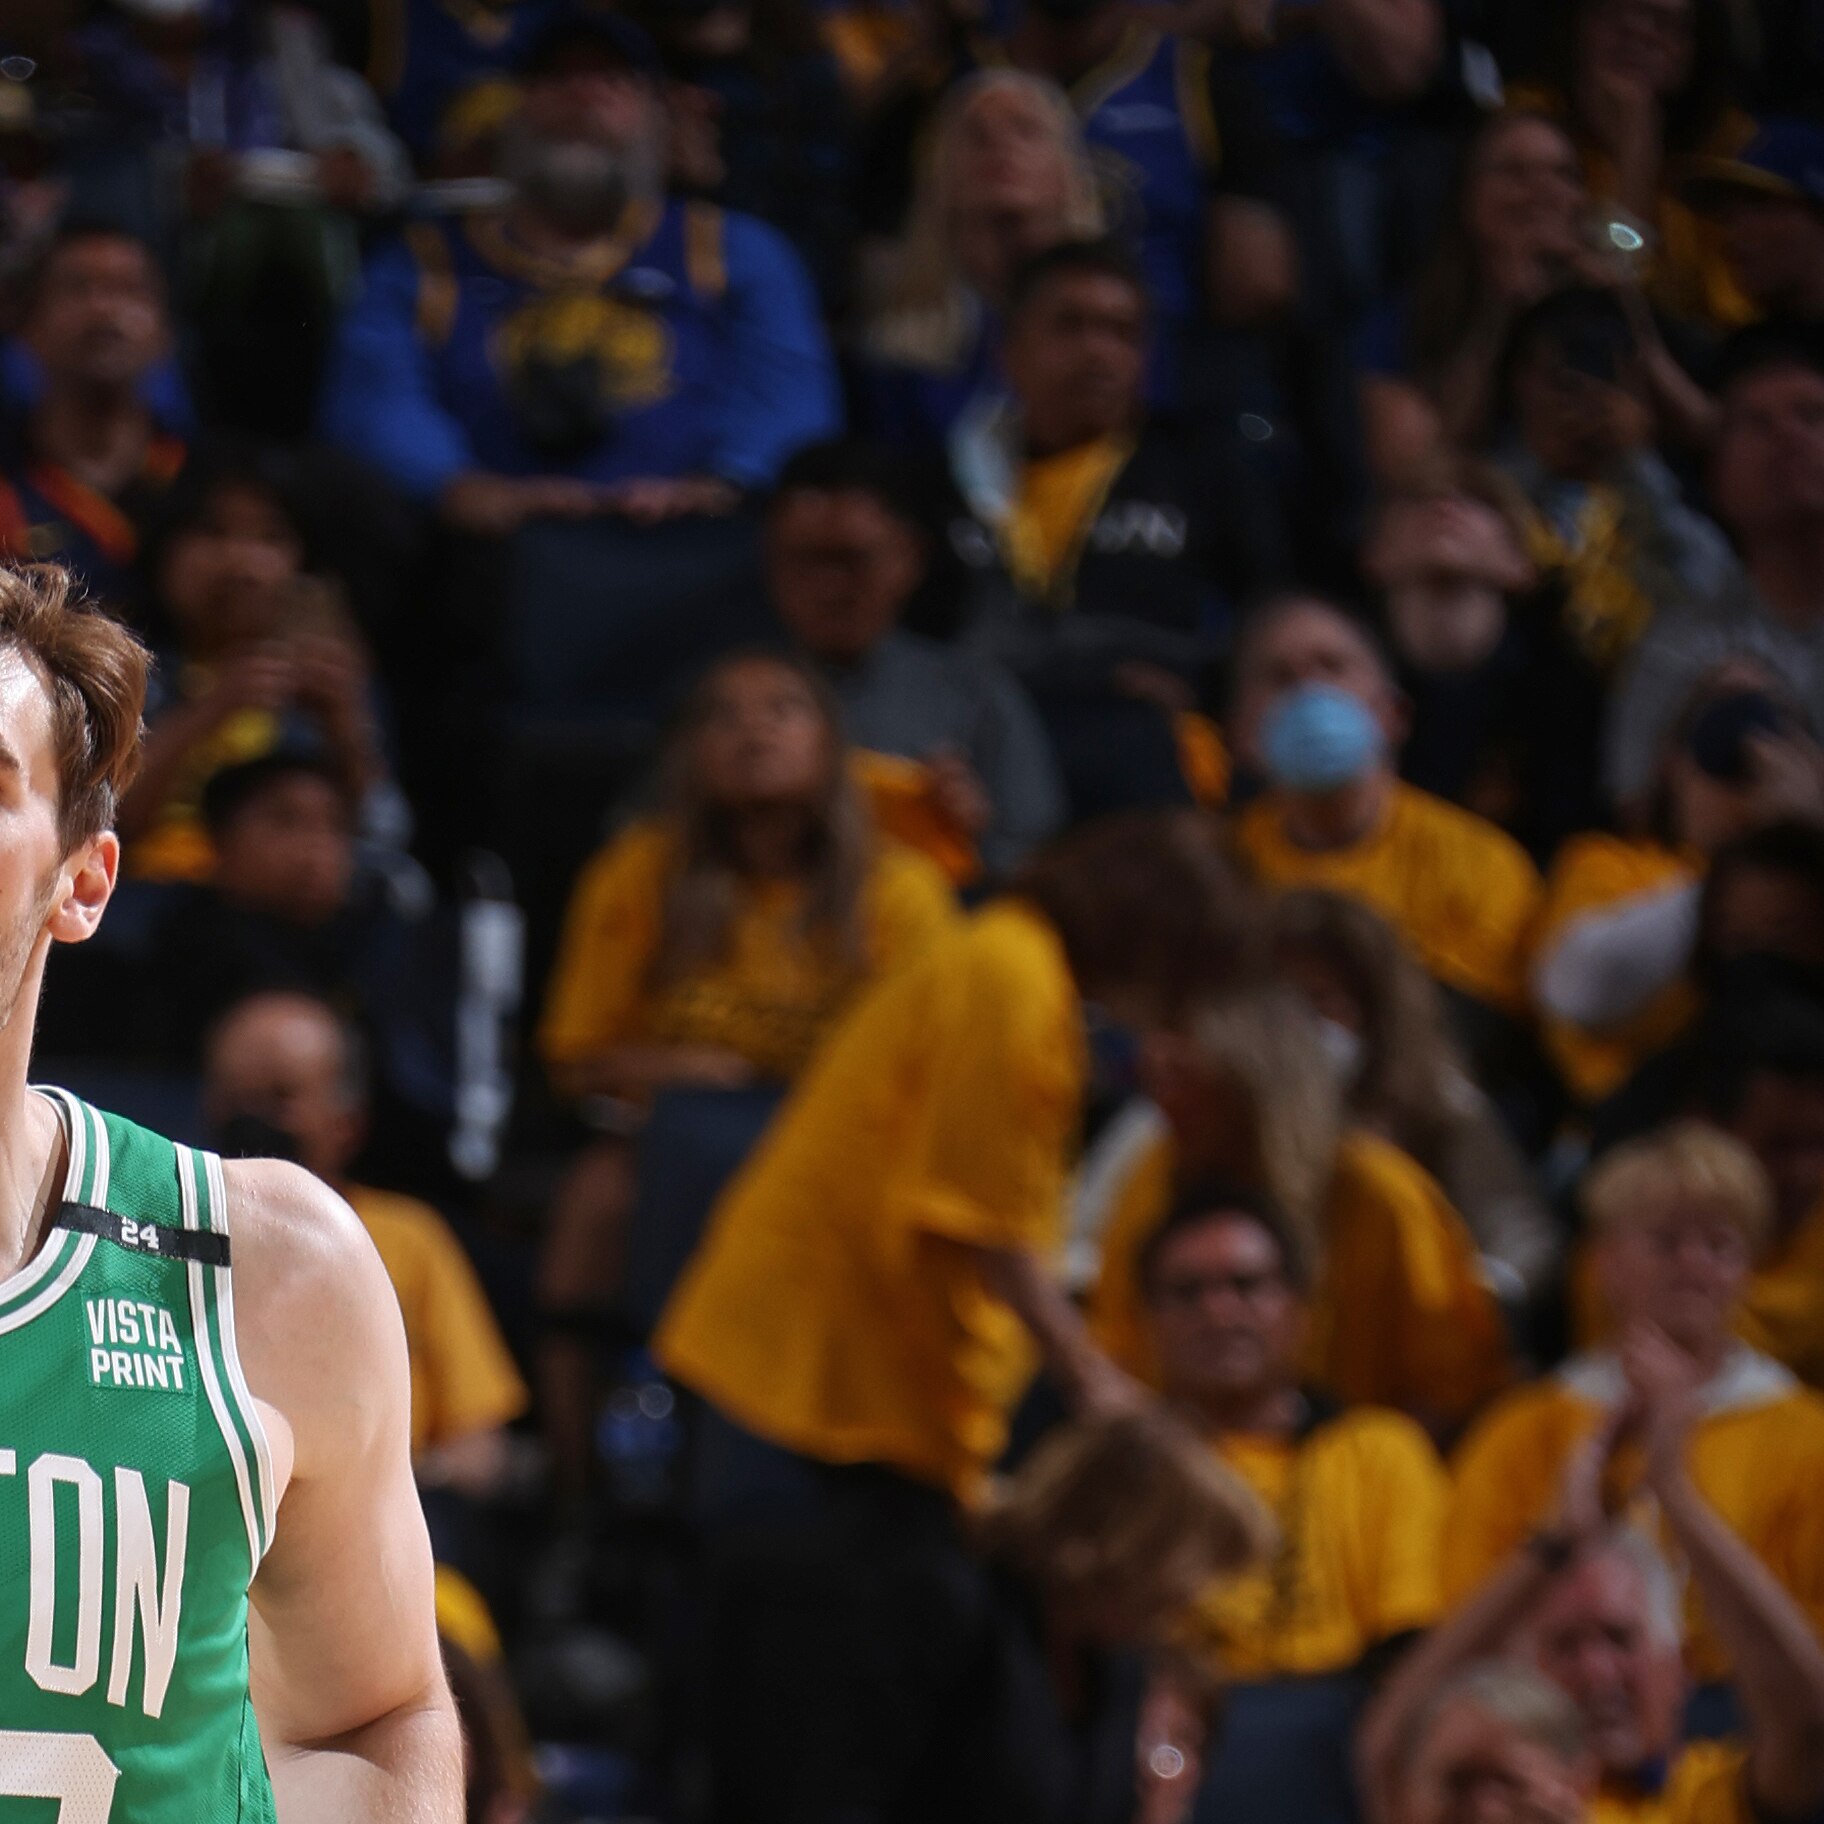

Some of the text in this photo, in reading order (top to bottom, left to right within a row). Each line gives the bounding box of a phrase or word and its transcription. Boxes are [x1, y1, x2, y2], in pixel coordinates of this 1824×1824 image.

[120, 1216, 160, 1249] 24
[86, 1299, 182, 1354] VISTA
[91, 1348, 185, 1390] PRINT
